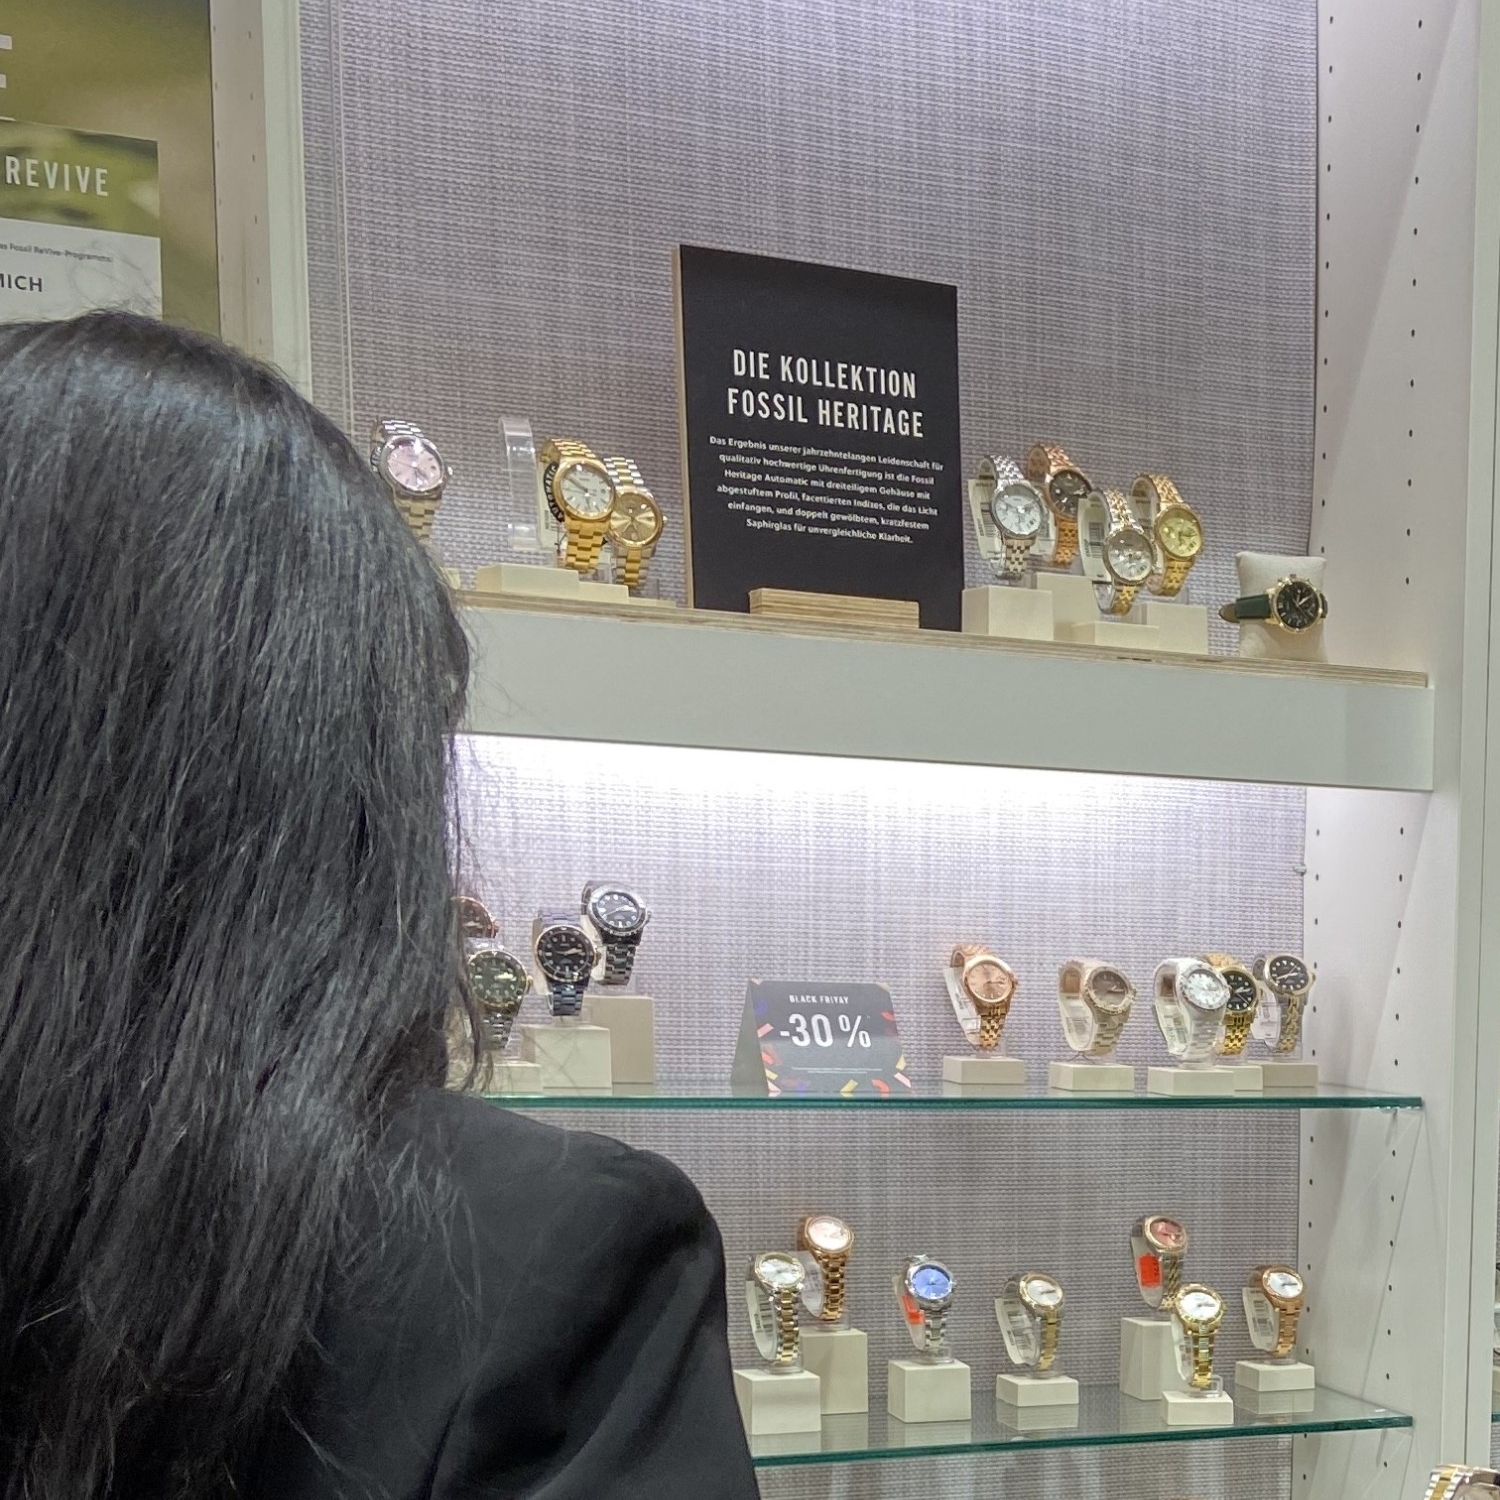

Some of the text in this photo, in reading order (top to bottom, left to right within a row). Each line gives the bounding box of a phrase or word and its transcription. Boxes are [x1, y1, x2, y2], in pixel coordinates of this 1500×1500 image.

[6, 156, 108, 198] REVIVE
[0, 272, 42, 292] ICH
[733, 349, 916, 399] DIE KOLLEKTION
[727, 387, 924, 438] FOSSIL HERITAGE
[709, 435, 944, 472] Das Ergebnis unserer jahrzehntelangen Leidenschaft für
[719, 454, 935, 485] qualitativ hochwertige Uhrenfertigung ist die Fossil
[724, 469, 931, 500] Heritage Automatic mit dreiteiligem Gehäuse mit
[716, 484, 938, 516] abgestuftem Profil, facettierten Indizes, die das Licht
[728, 501, 930, 530] einfangen, und doppelt gewölbtem, kratzfestem
[746, 518, 914, 544] Saphirglas für unvergleichliche Klarheit.
[788, 994, 818, 1004] BLACK
